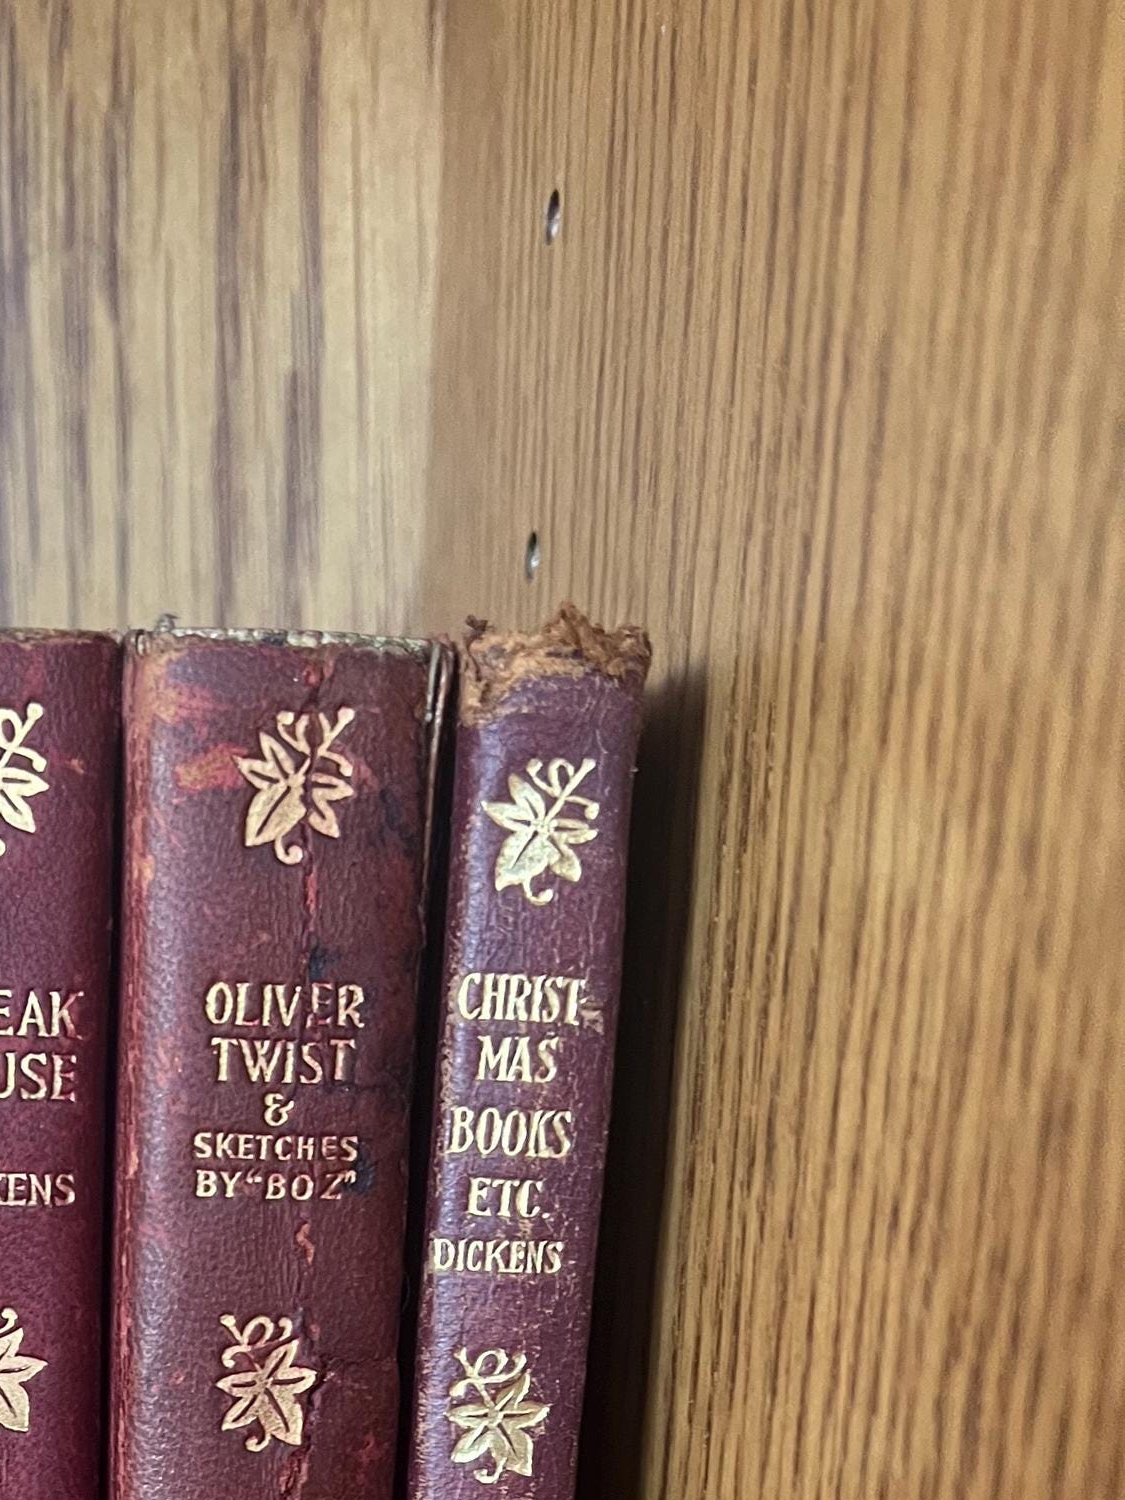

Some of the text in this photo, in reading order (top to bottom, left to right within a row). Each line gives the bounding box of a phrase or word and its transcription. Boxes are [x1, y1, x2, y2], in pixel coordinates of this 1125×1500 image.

[205, 981, 366, 1029] OLIVER
[211, 1037, 357, 1085] TWIST
[477, 1034, 560, 1083] MAS
[264, 1092, 295, 1126] &
[193, 1132, 359, 1162] SKETCHES
[445, 1106, 572, 1158] BOOKS
[195, 1169, 242, 1198] BY
[466, 1176, 551, 1219] ETC.
[432, 1238, 564, 1274] DICKENS
